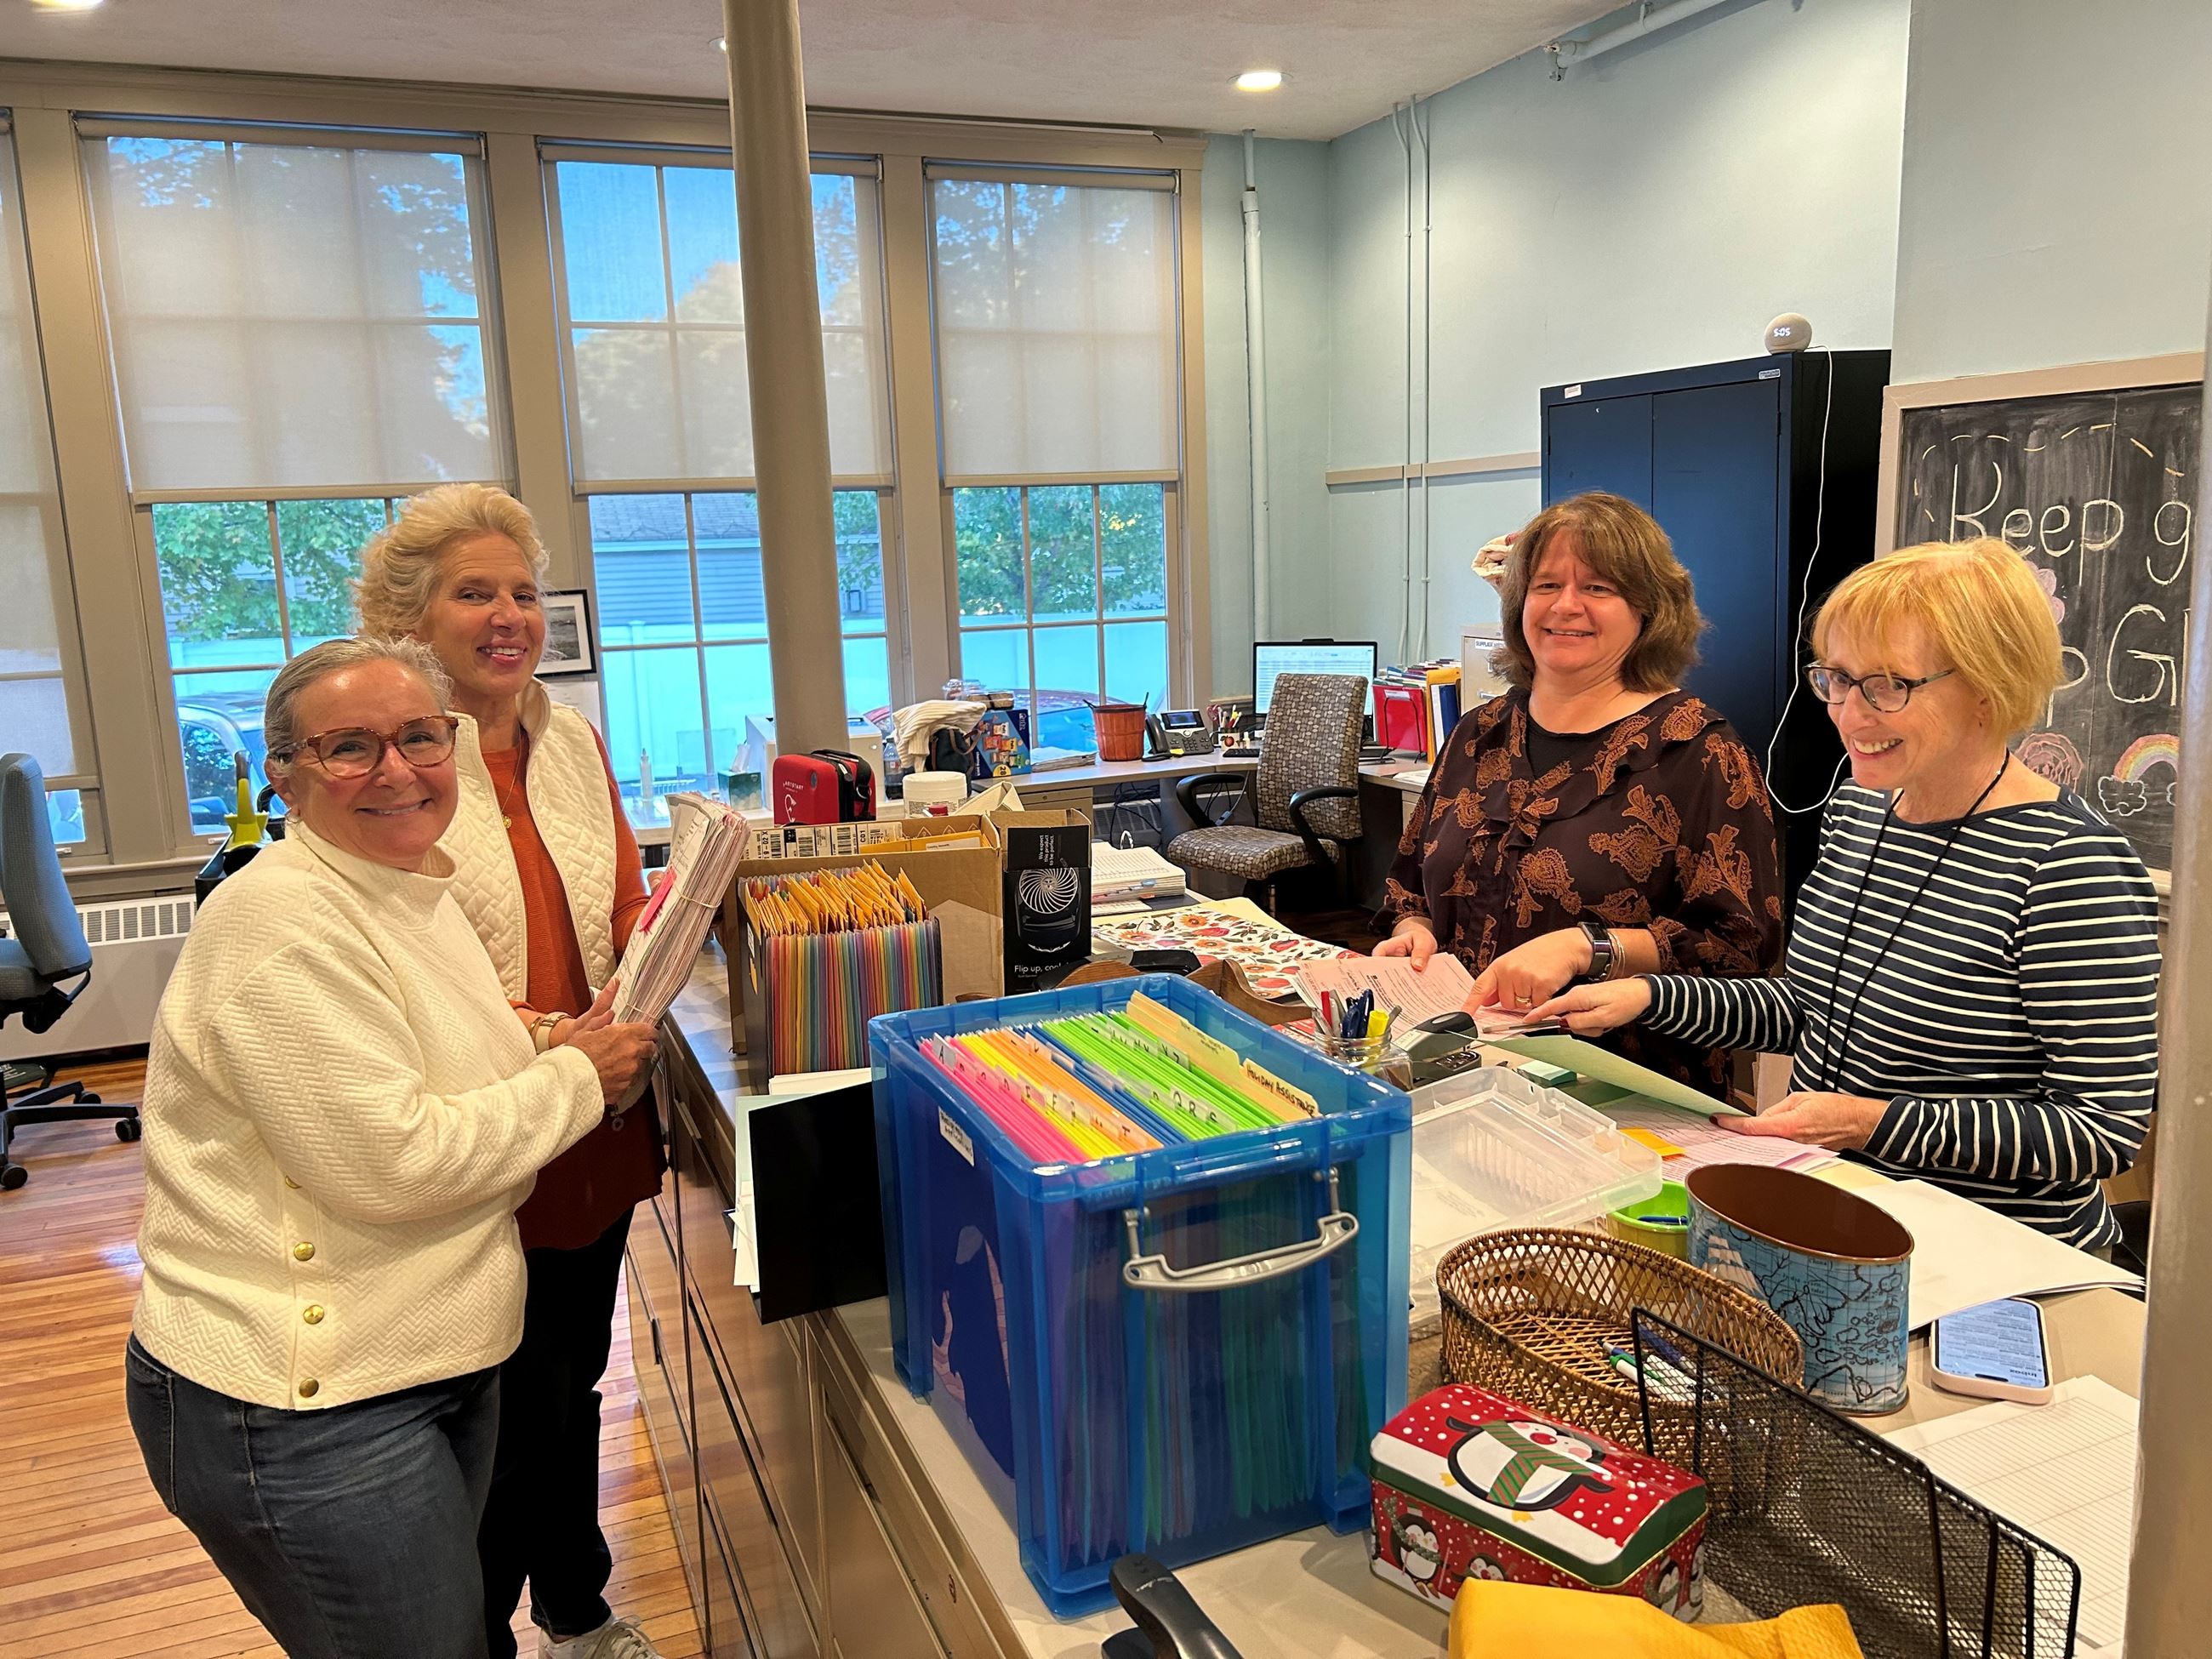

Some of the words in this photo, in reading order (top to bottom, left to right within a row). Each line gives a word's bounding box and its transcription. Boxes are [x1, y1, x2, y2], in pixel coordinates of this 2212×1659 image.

[1949, 461, 2124, 587] Keep
[1038, 851, 1044, 860] We
[1014, 965, 1029, 974] Flip
[1030, 966, 1043, 974] up,
[938, 1045, 945, 1065] A
[1246, 1063, 1274, 1094] HOLIDAY
[1188, 1100, 1197, 1118] R
[2009, 1368, 2038, 1377] Inbox
